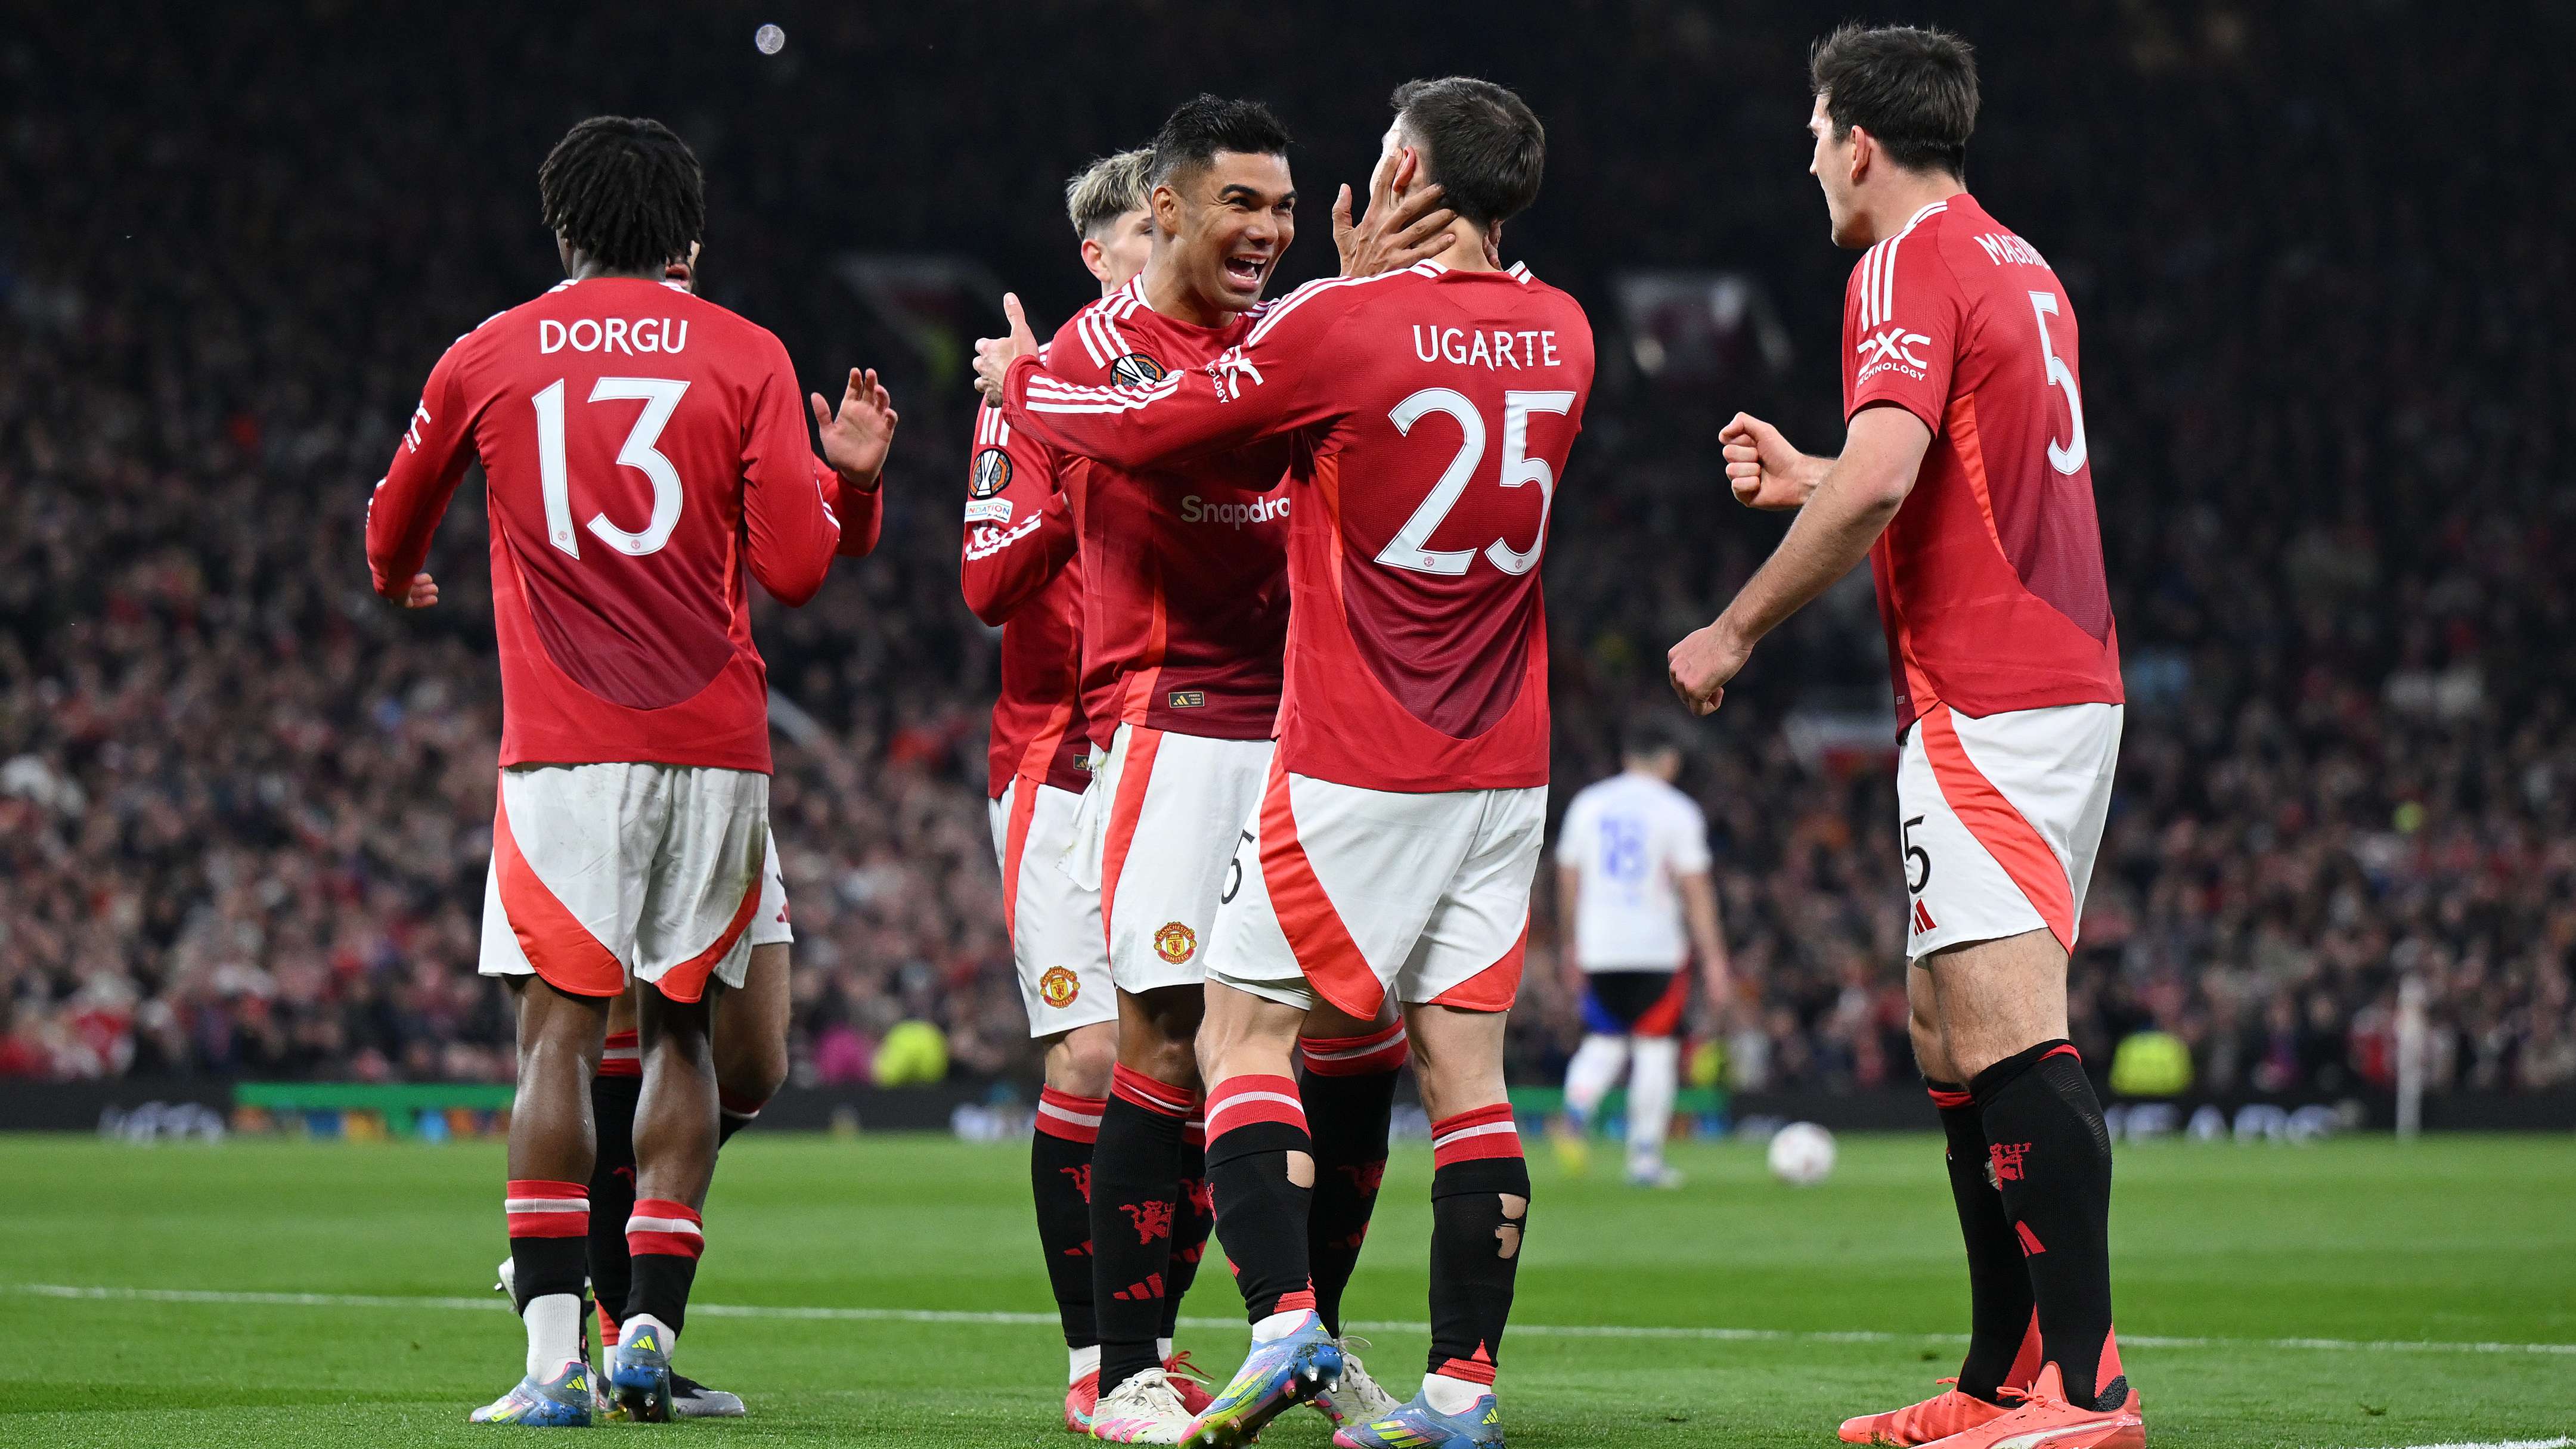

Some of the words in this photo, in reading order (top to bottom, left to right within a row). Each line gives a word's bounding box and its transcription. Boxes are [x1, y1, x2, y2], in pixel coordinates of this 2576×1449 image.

[540, 318, 689, 356] DORGU
[1412, 325, 1561, 371] UGARTE
[1857, 328, 1931, 377] DXC
[2028, 290, 2087, 476] 5
[532, 377, 692, 560] 13
[1374, 387, 1577, 576] 25
[1904, 814, 1931, 894] 5
[1157, 925, 1193, 940] MANCHESTER
[1042, 969, 1075, 985] MANCHESTER
[1165, 953, 1189, 962] UNITED
[1050, 996, 1074, 1006] UNITED
